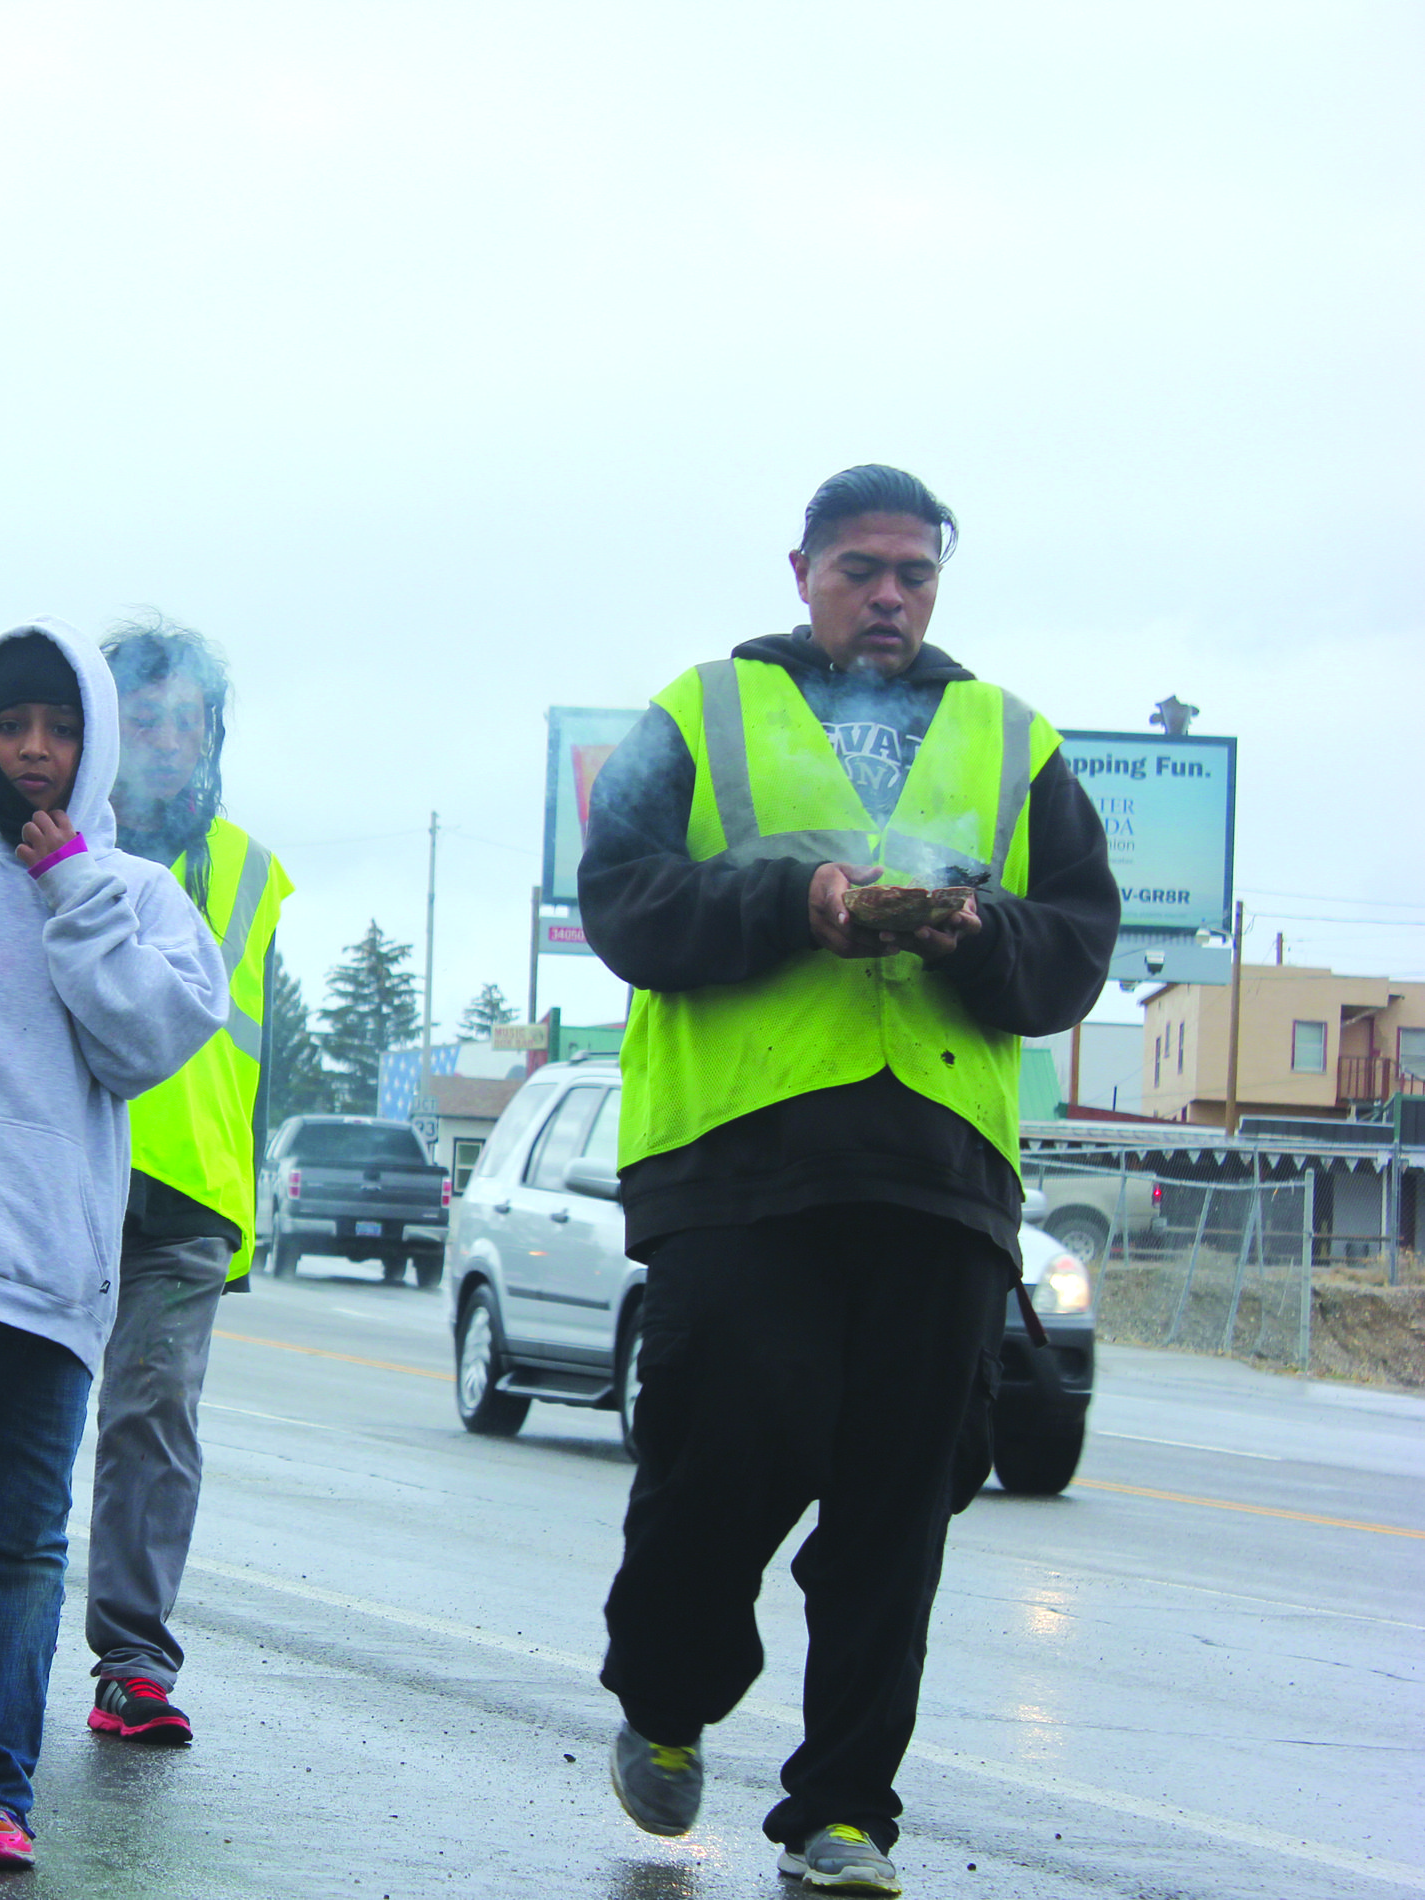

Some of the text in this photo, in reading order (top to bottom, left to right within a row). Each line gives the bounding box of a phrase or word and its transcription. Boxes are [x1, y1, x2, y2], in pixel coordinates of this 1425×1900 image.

[1156, 756, 1211, 779] Fun.
[1091, 797, 1135, 815] TER
[1121, 888, 1191, 905] V-GR8R
